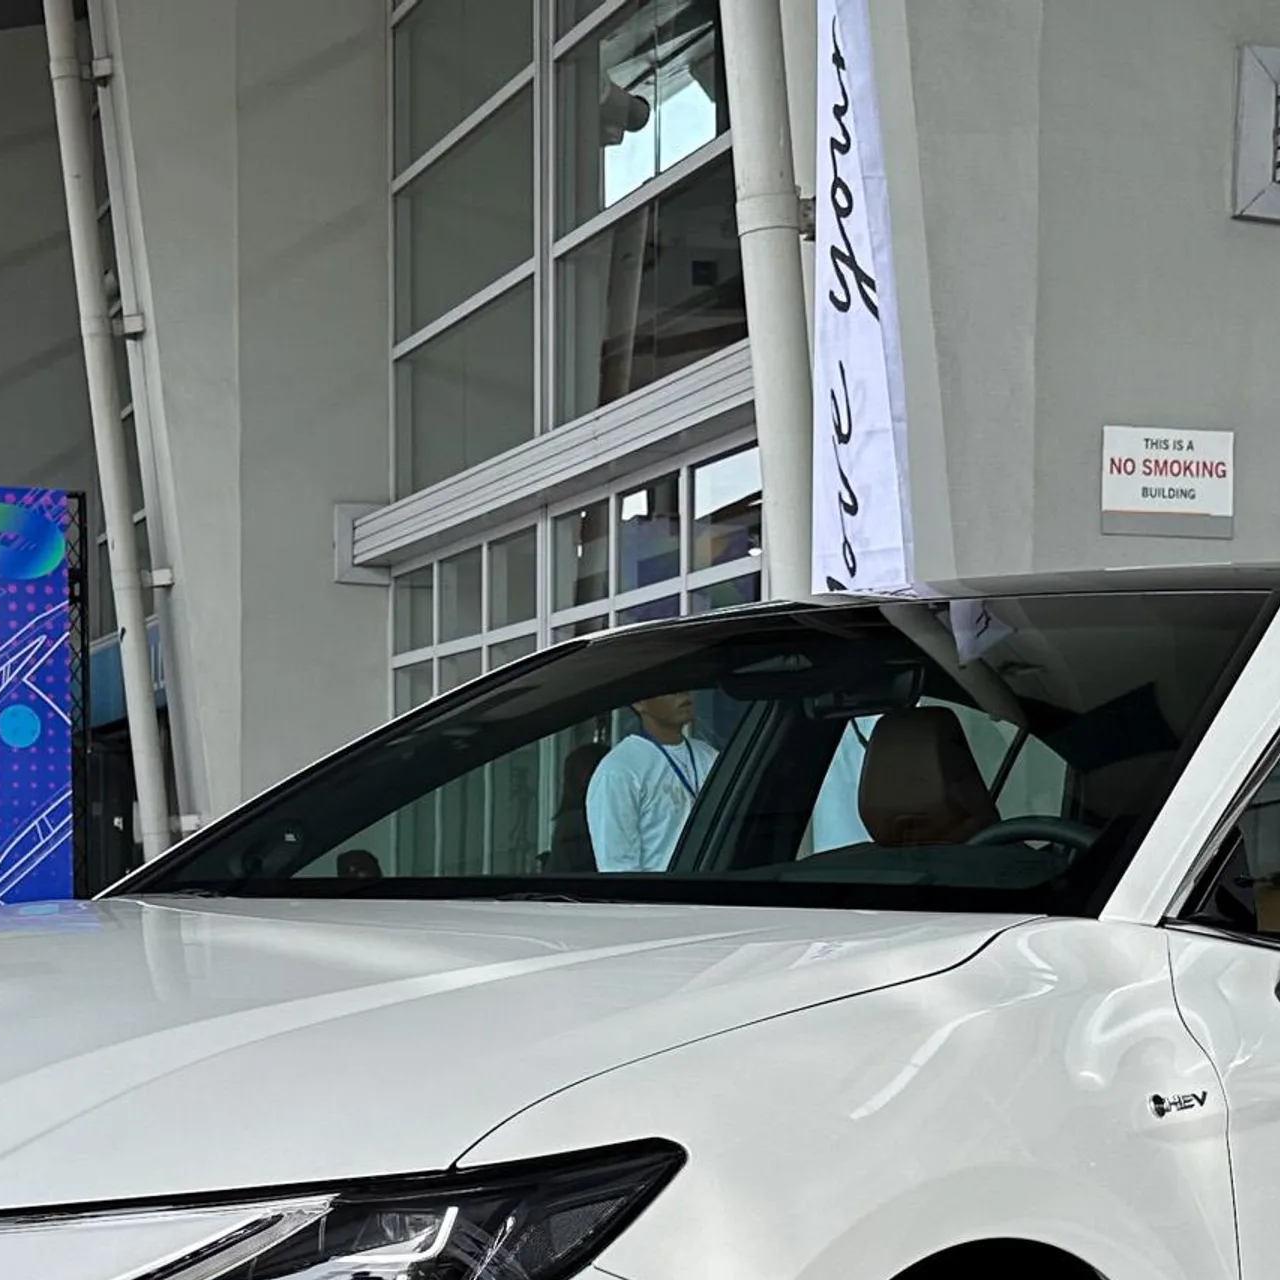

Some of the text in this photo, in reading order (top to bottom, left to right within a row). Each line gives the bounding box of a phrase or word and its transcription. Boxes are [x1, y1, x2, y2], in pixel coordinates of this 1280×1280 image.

[829, 15, 879, 320] your
[1143, 438, 1194, 451] THIS IS A
[1109, 457, 1227, 479] NO SMOKING
[1141, 487, 1197, 500] BUILDING
[1164, 1091, 1207, 1112] HEV
